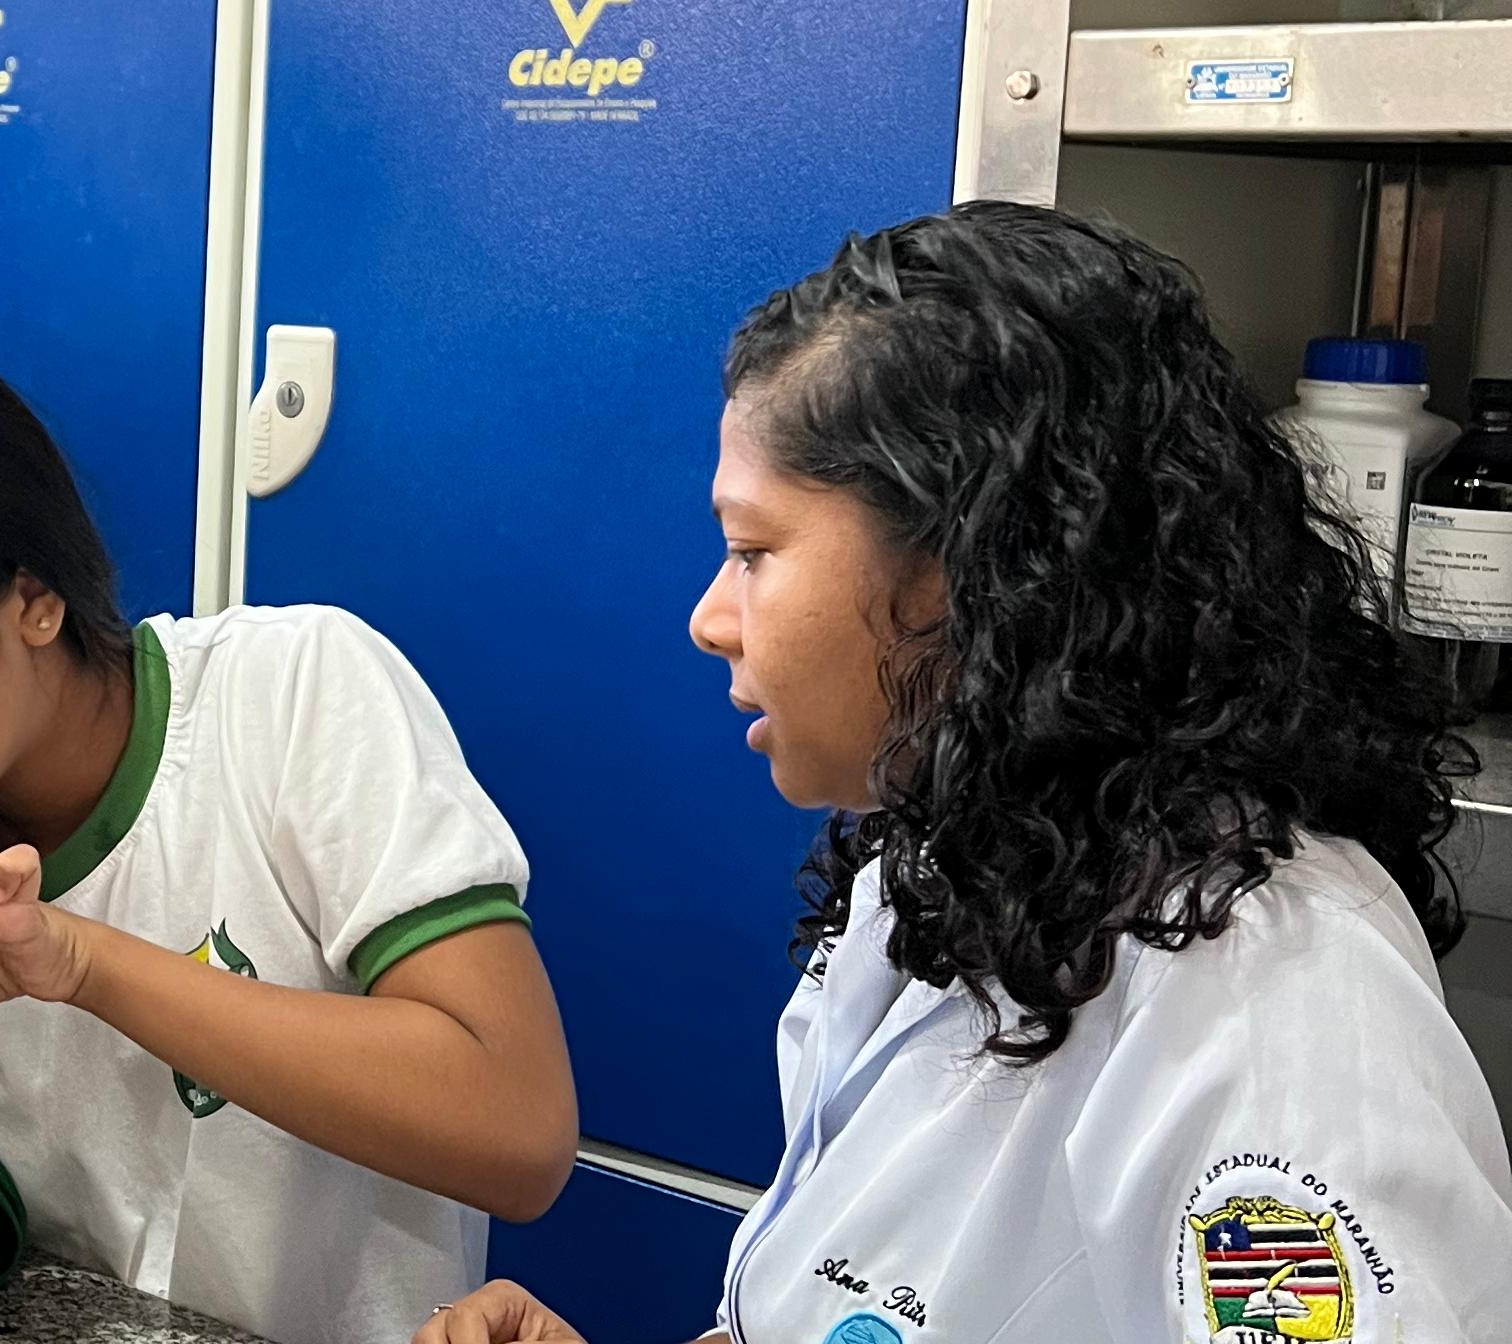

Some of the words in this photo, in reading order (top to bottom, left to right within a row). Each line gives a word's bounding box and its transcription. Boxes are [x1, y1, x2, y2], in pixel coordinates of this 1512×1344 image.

[508, 47, 644, 96] Cidepe
[1301, 1172, 1329, 1197] DO
[814, 1258, 871, 1295] Ana
